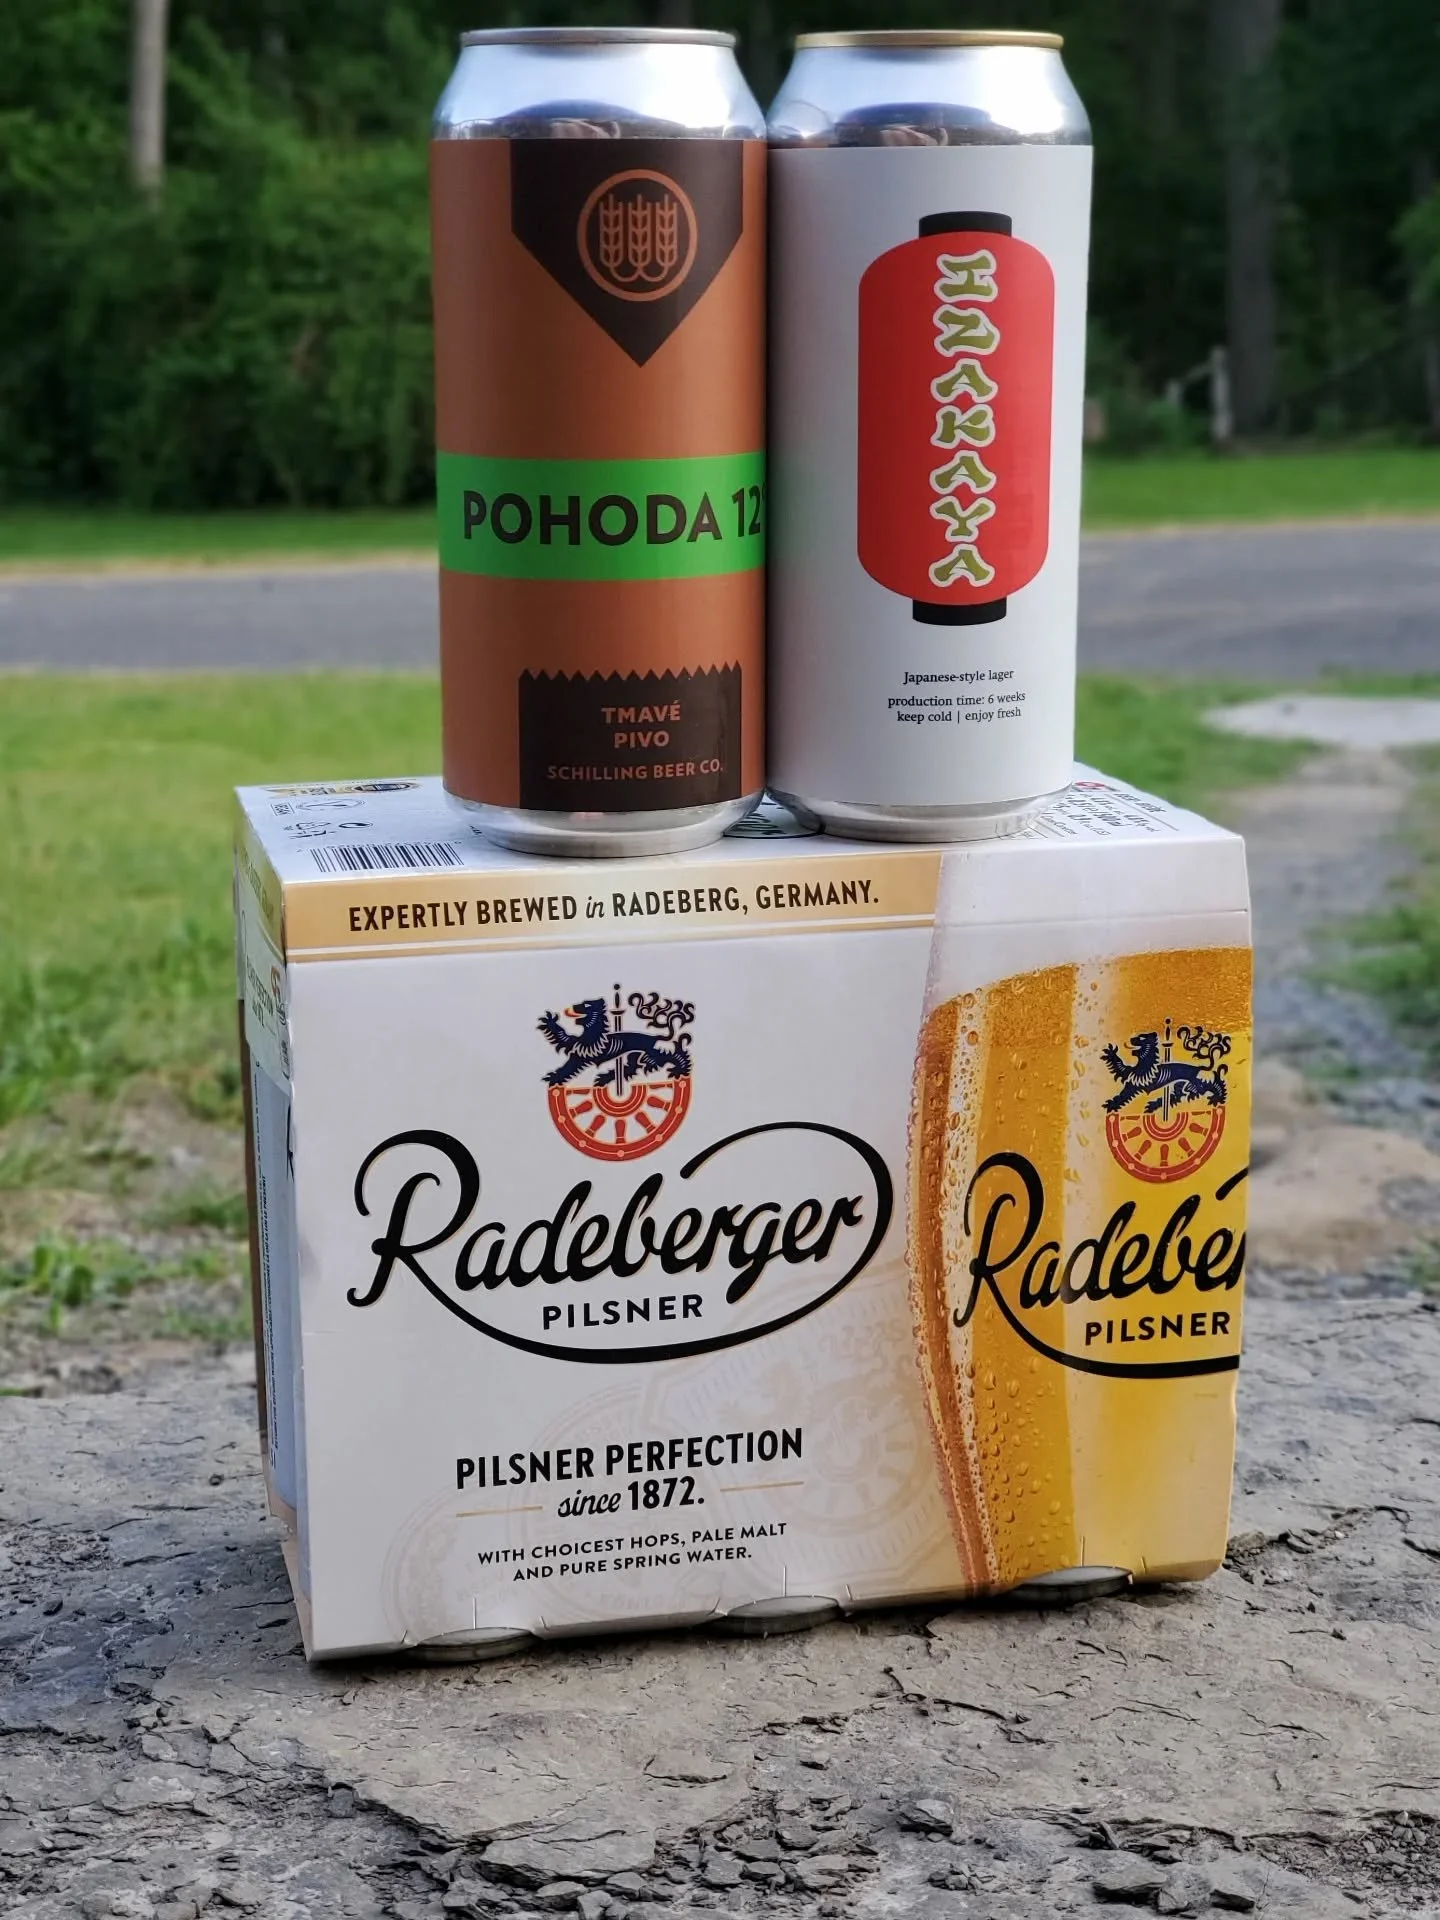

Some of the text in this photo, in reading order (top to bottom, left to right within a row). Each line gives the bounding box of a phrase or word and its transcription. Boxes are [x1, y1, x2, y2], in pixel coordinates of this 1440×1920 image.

[929, 249, 1000, 587] IZAKAYA
[463, 490, 723, 546] POHODA
[903, 669, 1014, 685] Japanese-style lager
[601, 700, 681, 724] TMAVÉ
[888, 691, 1026, 708] production time: 6 weeks
[897, 711, 924, 724] keep
[928, 710, 952, 722] cold
[965, 710, 994, 723] enjoy
[997, 707, 1021, 719] fresh
[613, 730, 670, 749] PIVO
[547, 758, 724, 781] SCHILLING BEER CO.
[349, 880, 879, 932] EXPERTLY BREWED in RADEBERG, GERMANY.
[347, 1128, 864, 1308] Radeberger
[542, 1293, 704, 1330] PILSNER
[1085, 1311, 1231, 1346] PILSNER
[456, 1427, 803, 1490] PILSNER PERFECTION
[558, 1475, 705, 1518] since 1872.
[478, 1523, 788, 1565] WITH CHOICEST HOPS, PALE MALT
[513, 1546, 753, 1582] AND PURE SPRING WATER.
